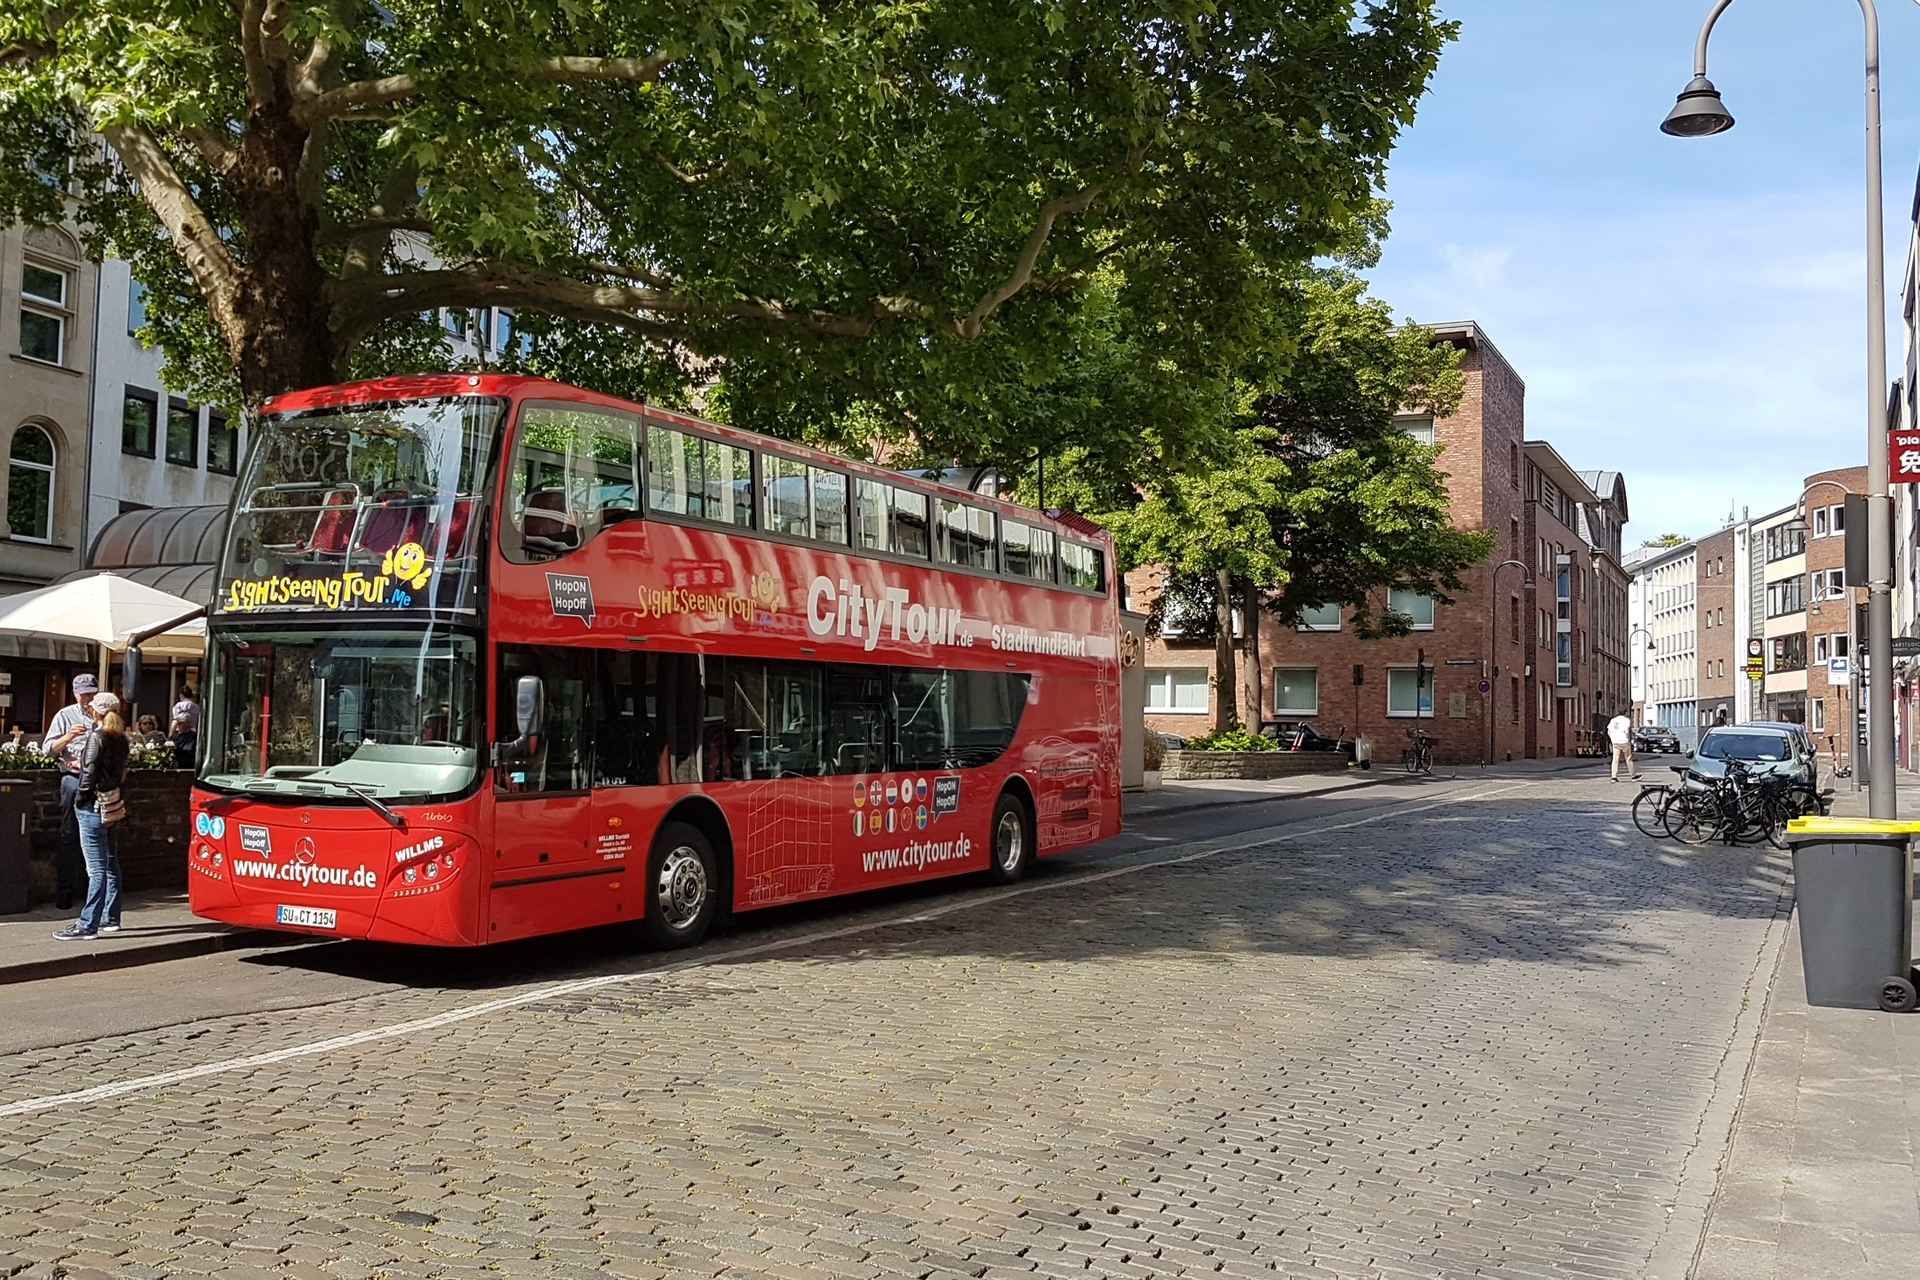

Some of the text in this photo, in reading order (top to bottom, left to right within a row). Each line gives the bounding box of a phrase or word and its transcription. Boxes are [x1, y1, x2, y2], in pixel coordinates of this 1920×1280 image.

[555, 579, 587, 595] HopON
[555, 596, 588, 612] HopOff
[991, 624, 1086, 657] Stadtrundfahrt
[395, 835, 444, 863] WILLMS
[862, 831, 971, 873] www.citytour.de
[233, 859, 377, 887] www.citytour.de
[282, 908, 334, 925] SU CT 1154
